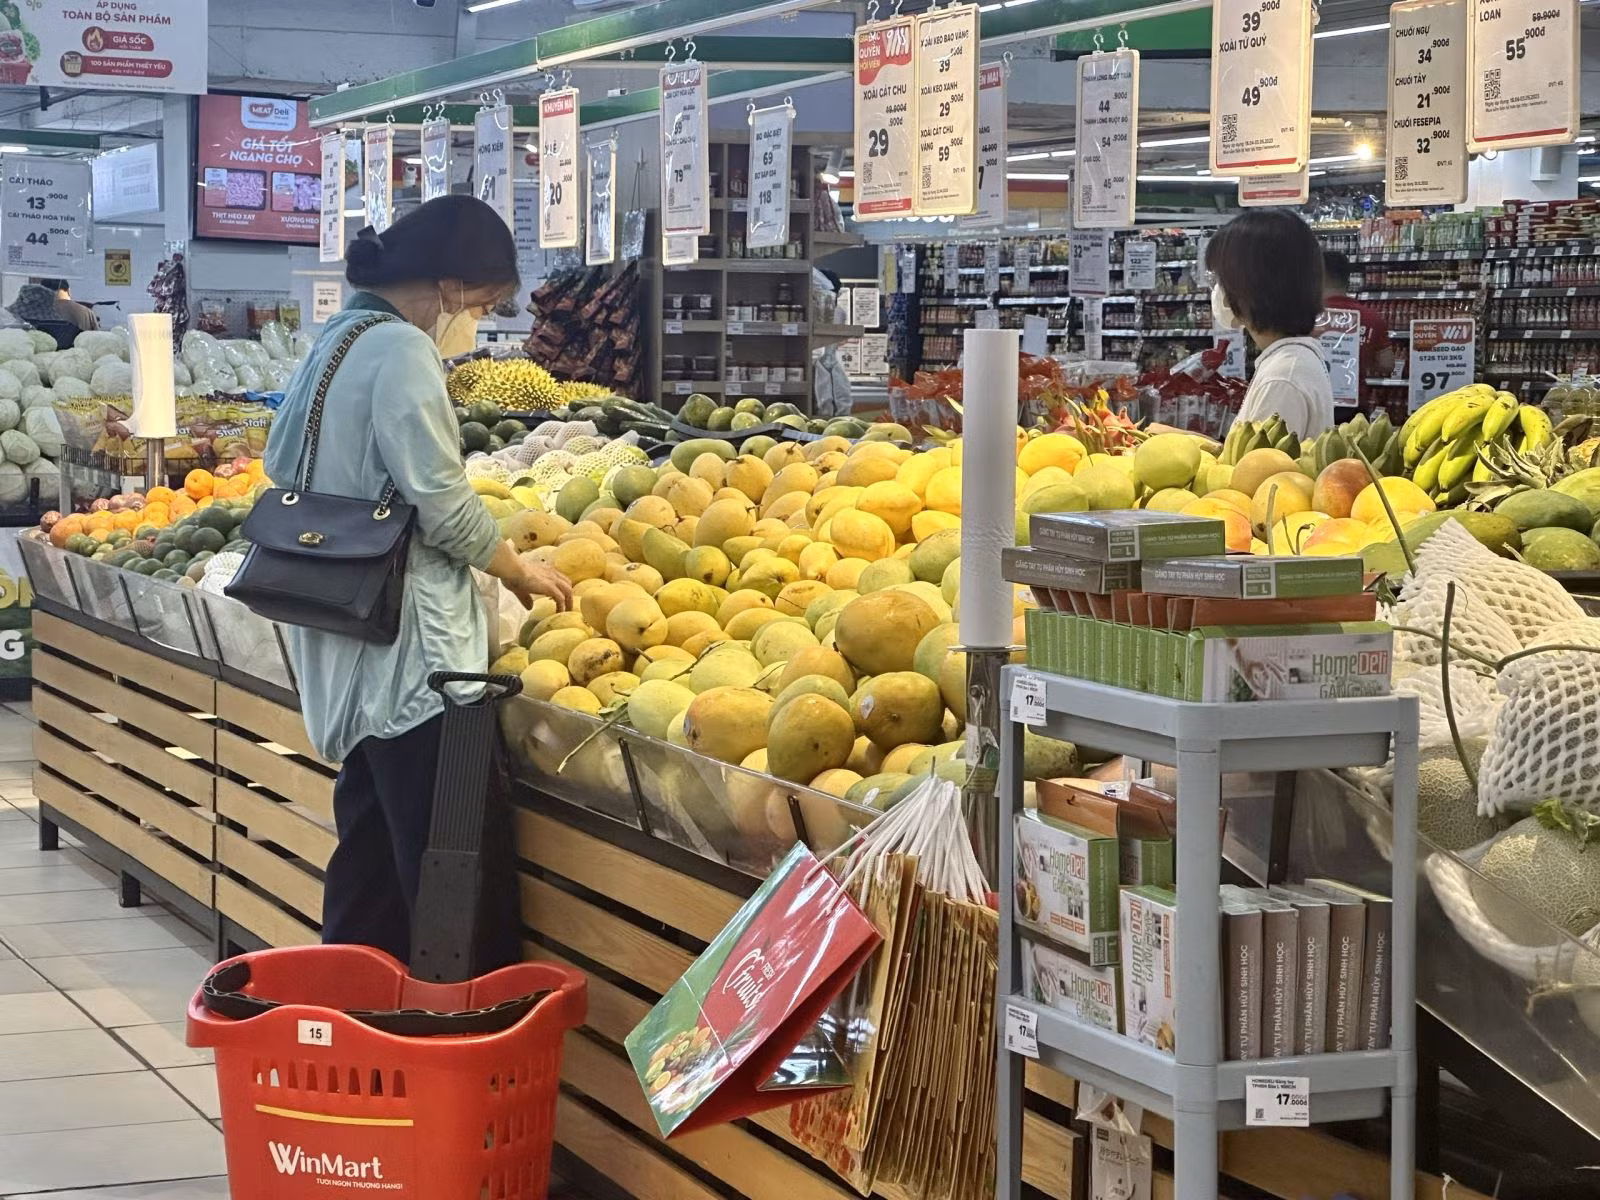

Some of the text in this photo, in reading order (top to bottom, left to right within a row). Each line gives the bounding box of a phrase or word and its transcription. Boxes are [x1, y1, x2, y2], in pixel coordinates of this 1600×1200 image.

[1242, 11, 1261, 33] 39
[1479, 8, 1502, 22] LOAN
[1219, 38, 1237, 53] XOÀI
[1250, 33, 1267, 48] QUÝ
[1505, 36, 1526, 61] 55
[1417, 48, 1432, 64] 34
[939, 59, 951, 73] 39
[863, 87, 878, 101] XOÀI
[1242, 86, 1261, 107] 49
[1417, 93, 1431, 108] 21
[939, 101, 951, 118] 29
[1098, 100, 1110, 113] 44
[1412, 116, 1441, 127] FESEPIA
[868, 128, 889, 158] 29
[1101, 136, 1112, 148] 54
[1416, 138, 1431, 154] 32
[230, 151, 273, 163] NGANG
[763, 151, 774, 166] 69
[938, 145, 950, 163] 59
[674, 168, 684, 183] 79
[26, 196, 46, 210] 13
[758, 189, 772, 205] 118
[25, 232, 49, 245] 44
[1420, 372, 1450, 391] 97
[1312, 651, 1388, 677] HomeDeli
[1026, 695, 1034, 705] 17
[308, 1028, 323, 1040] 15
[1019, 1025, 1026, 1036] 17
[1276, 1093, 1290, 1105] 17
[268, 1140, 384, 1180] WinMart
